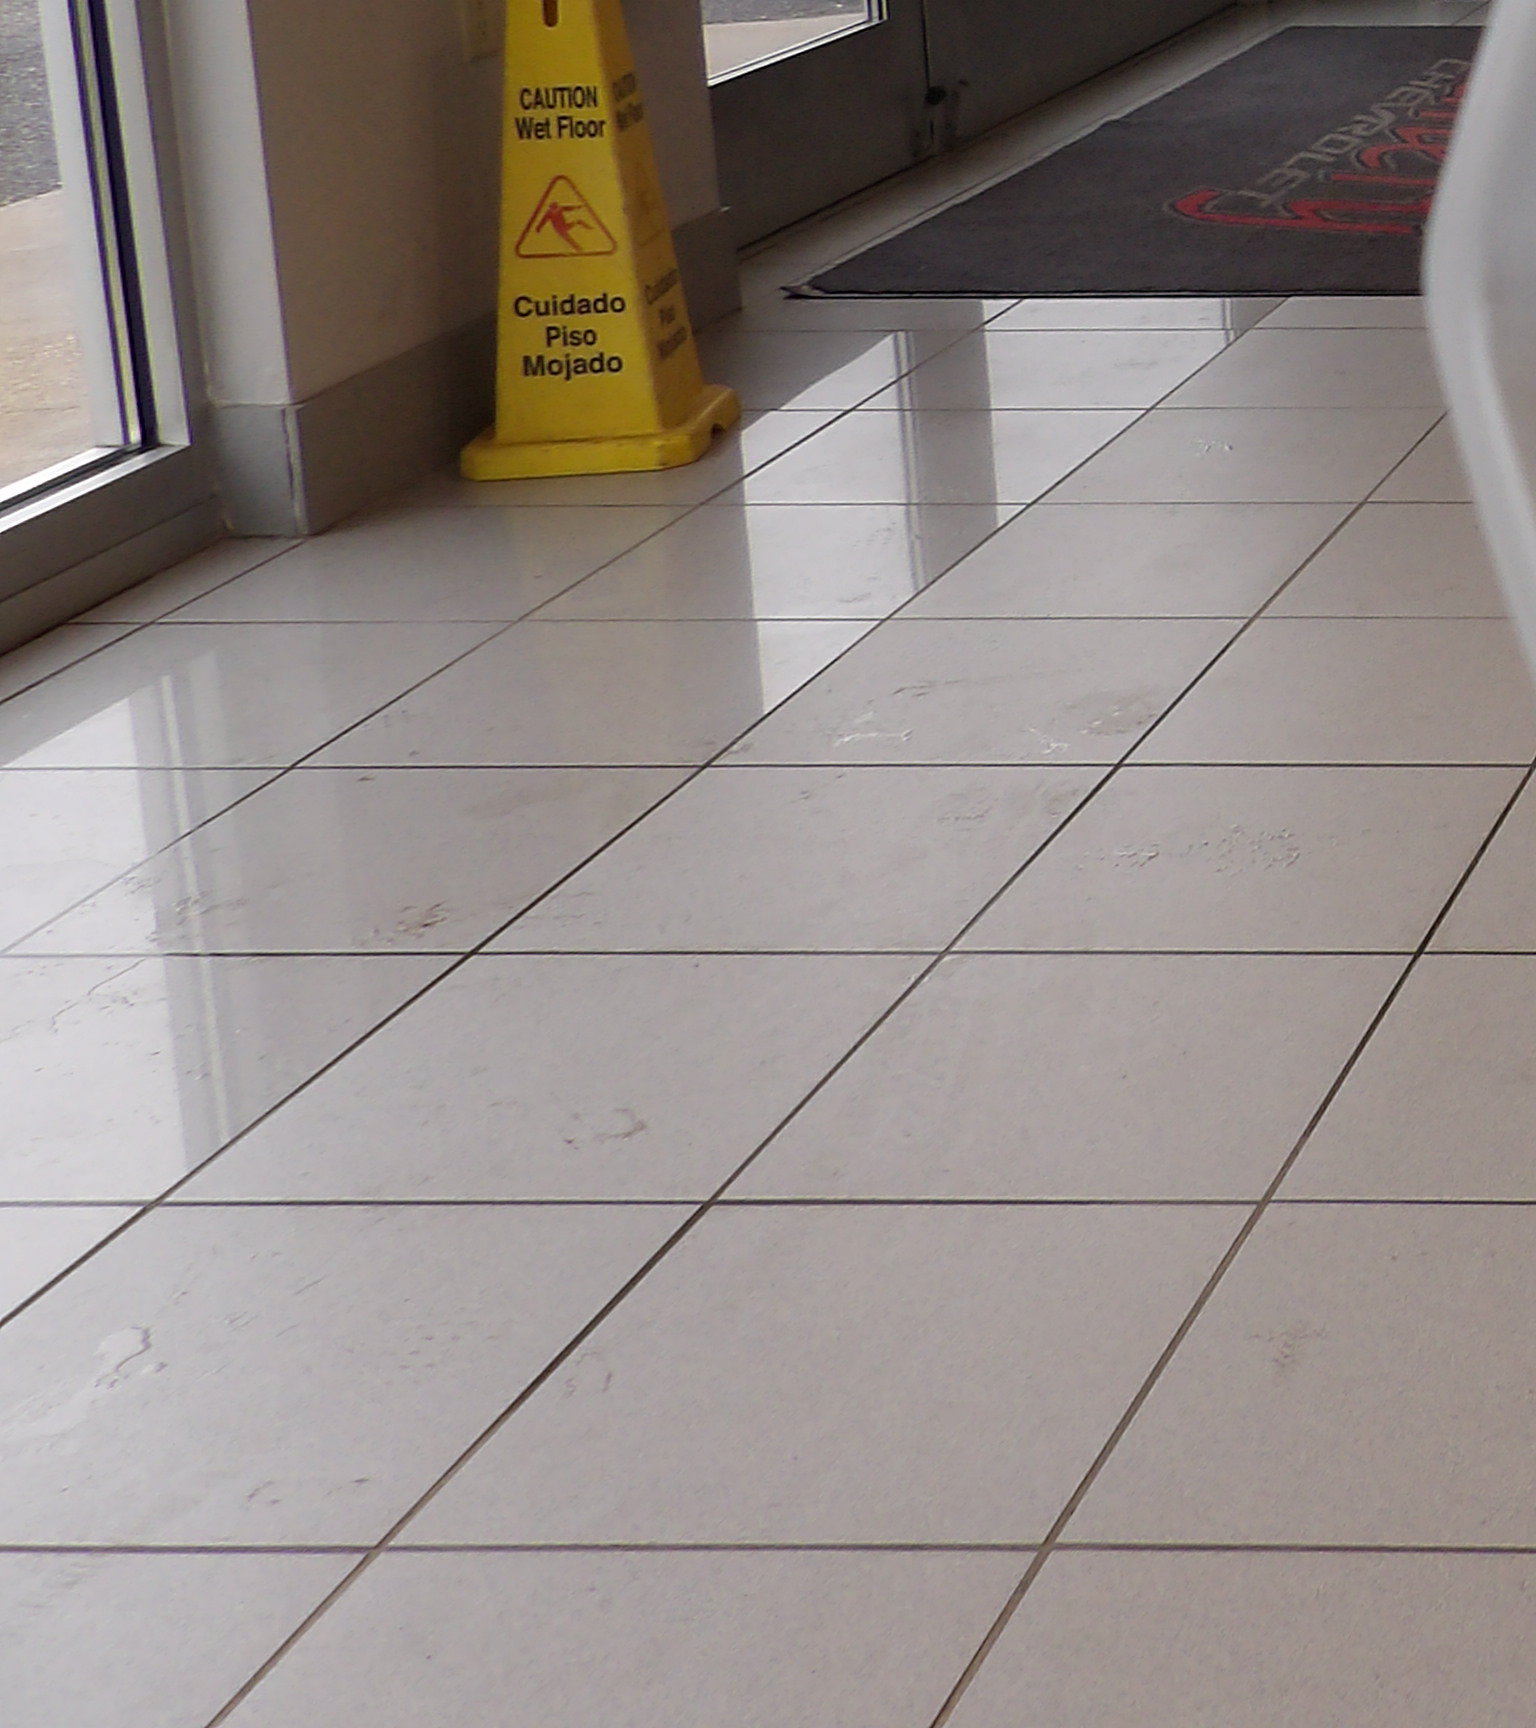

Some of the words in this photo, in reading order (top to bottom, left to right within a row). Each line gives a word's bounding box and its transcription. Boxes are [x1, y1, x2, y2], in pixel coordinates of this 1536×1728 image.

[519, 86, 598, 110] CAUTION
[514, 117, 552, 140] Wet
[557, 115, 606, 139] Floor
[514, 292, 626, 317] Cuidado
[546, 325, 597, 347] Piso
[523, 352, 623, 381] Mojado
